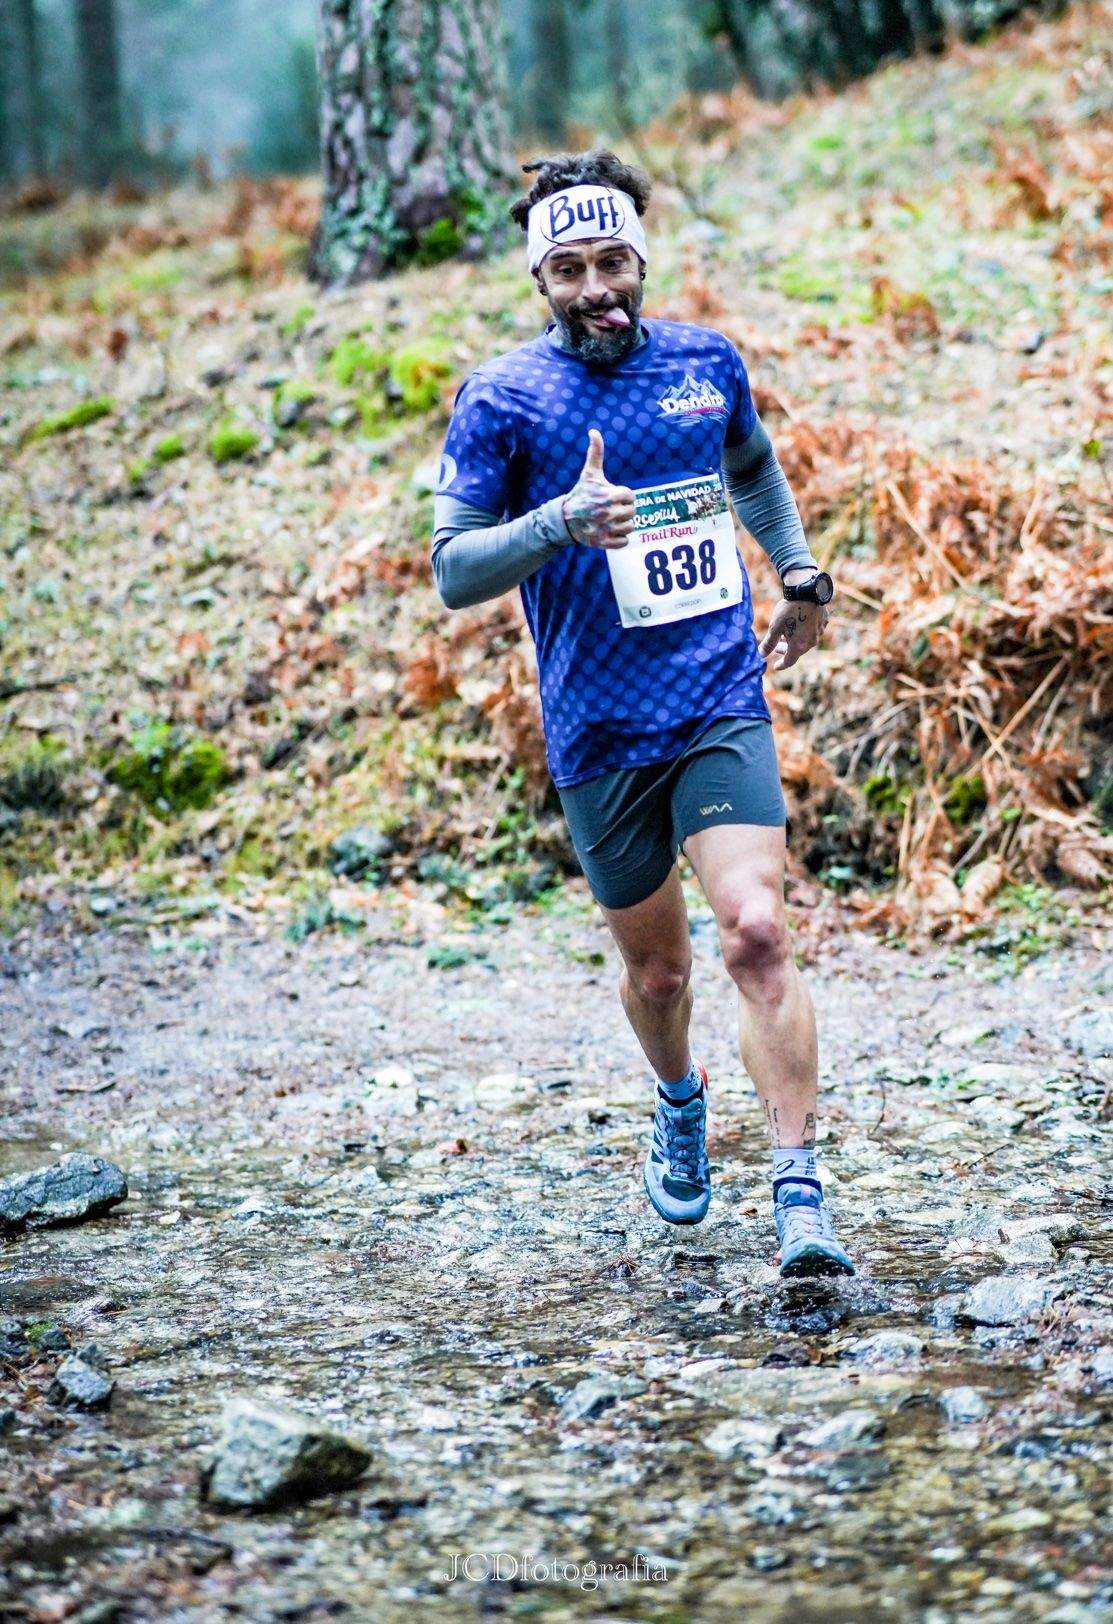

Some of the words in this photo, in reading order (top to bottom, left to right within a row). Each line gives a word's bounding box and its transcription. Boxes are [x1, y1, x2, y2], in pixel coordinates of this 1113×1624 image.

[666, 485, 711, 501] NAVIDAD
[639, 529, 667, 543] Trail
[669, 526, 693, 538] Run
[644, 538, 717, 596] 838
